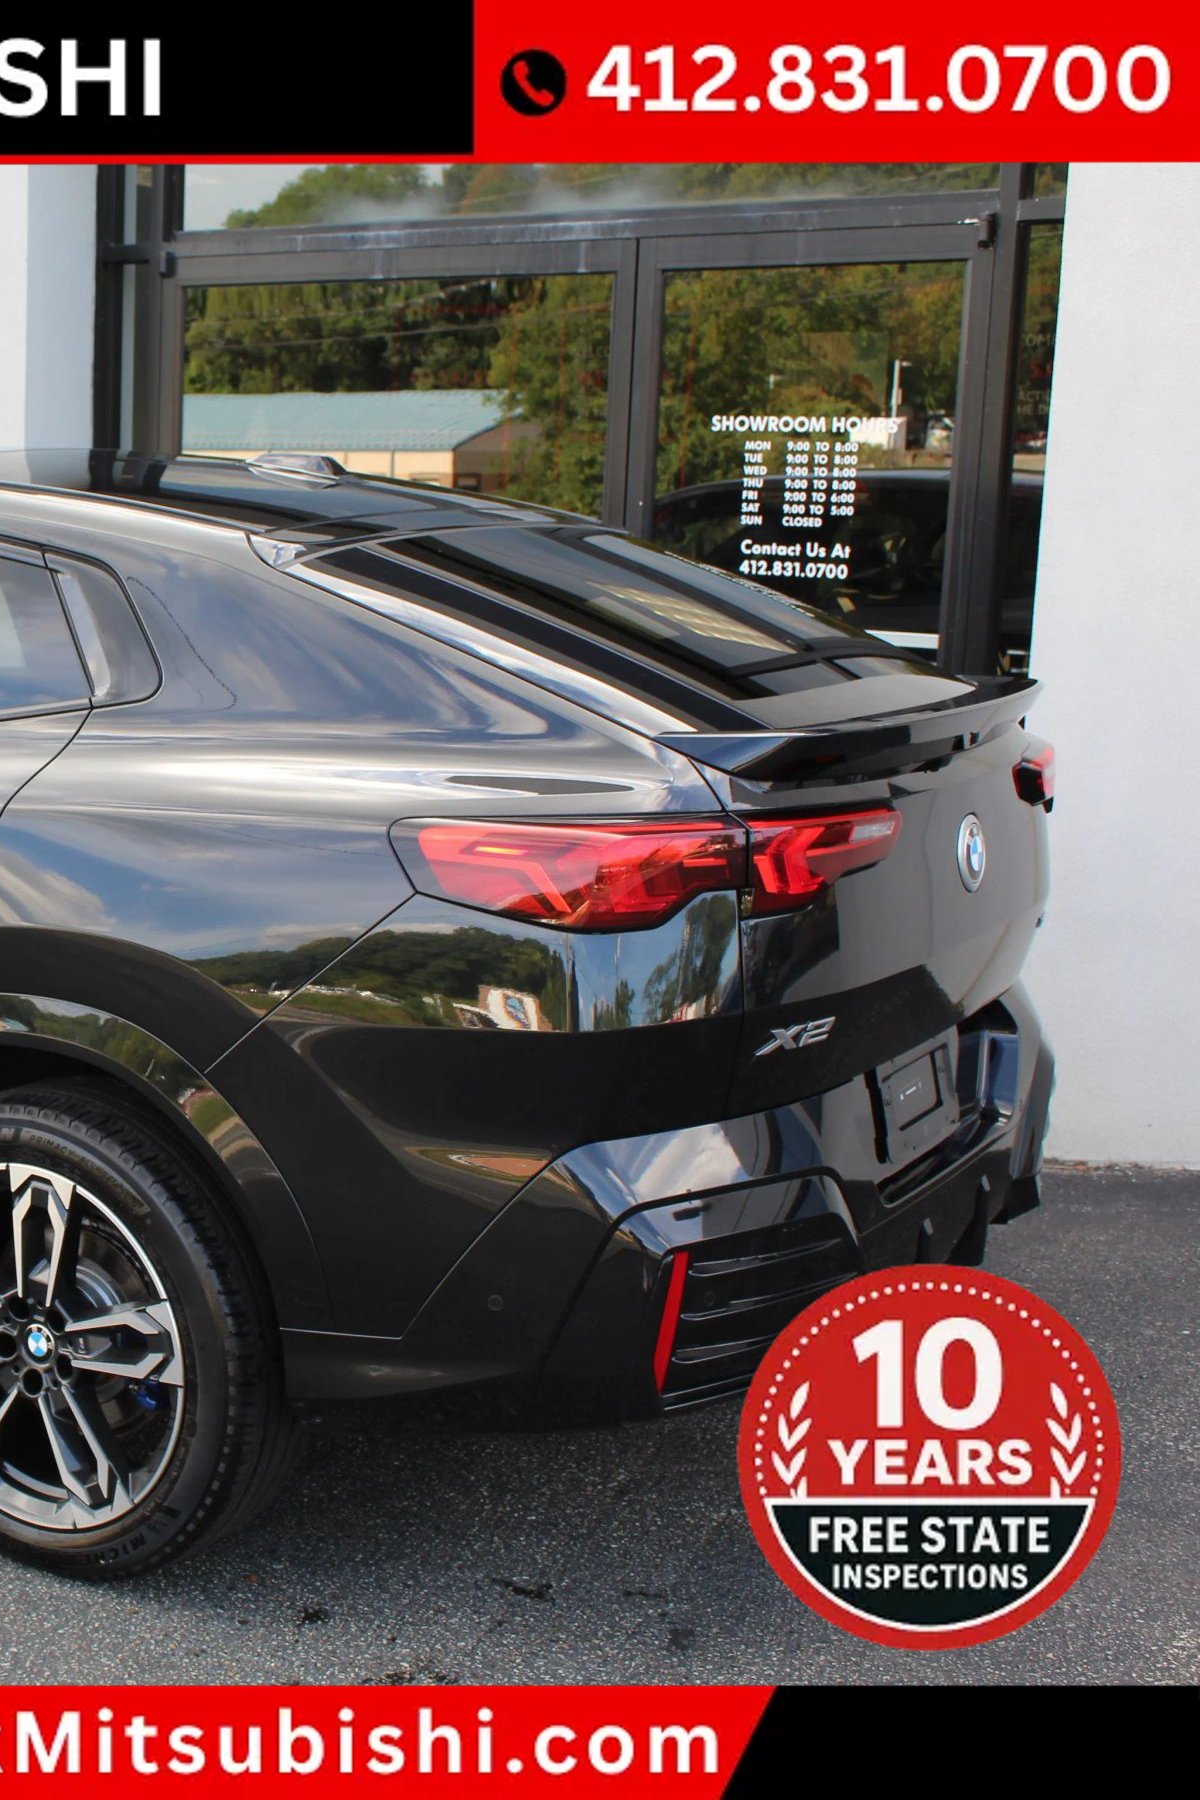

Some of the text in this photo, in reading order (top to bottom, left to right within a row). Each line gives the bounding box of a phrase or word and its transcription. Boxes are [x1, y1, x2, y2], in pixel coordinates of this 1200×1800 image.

[711, 415, 899, 433] SHOWROOM HOURS
[744, 441, 858, 452] MON 9:00 TO 8:00
[744, 454, 858, 465] TUE 9:00 TO 8:00
[744, 466, 856, 478] WED 9:00 TO 8:00
[743, 478, 856, 490] THU 9:00 TO 8:00
[742, 491, 854, 503] FRI 9:00 TO 6:00
[741, 503, 854, 516] SAT 9:00 TO 5:00
[740, 515, 822, 527] SUN CLOSED
[740, 540, 851, 559] Contact Us At
[739, 560, 848, 579] 412.831.0700
[754, 1016, 836, 1056] X2
